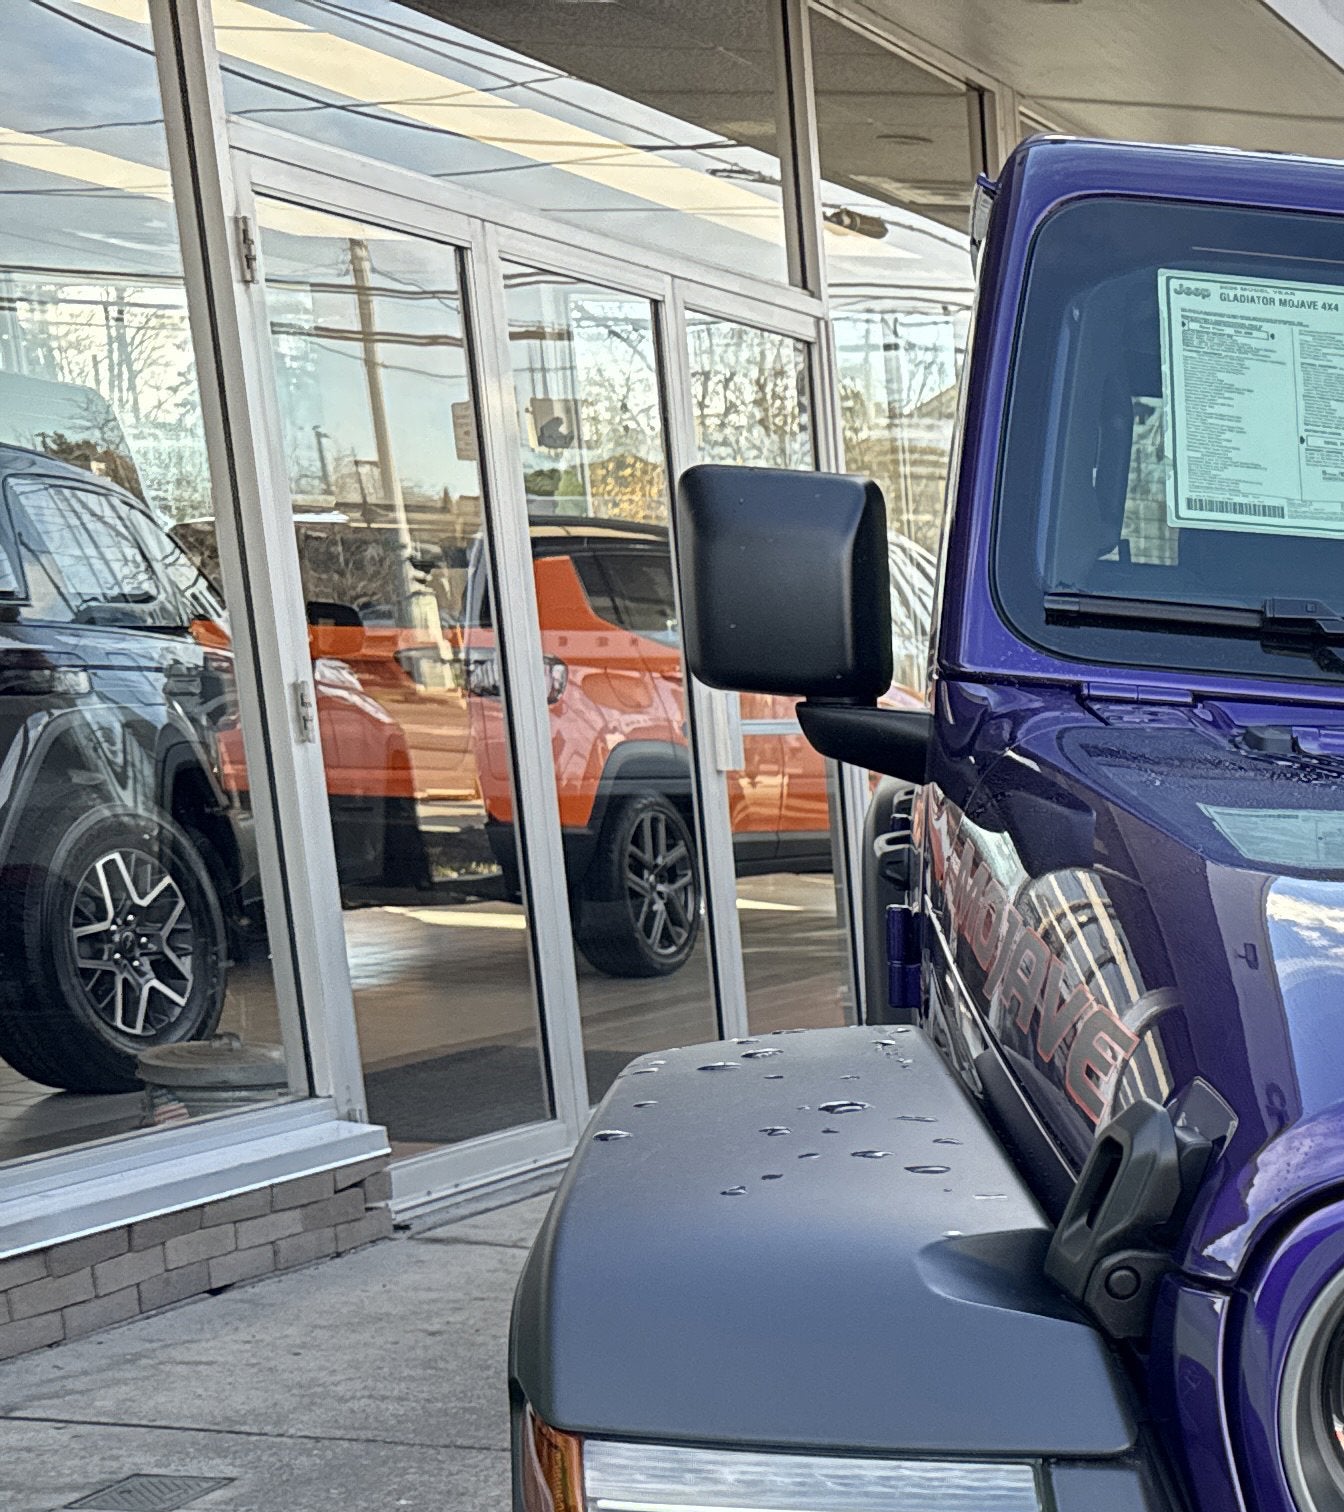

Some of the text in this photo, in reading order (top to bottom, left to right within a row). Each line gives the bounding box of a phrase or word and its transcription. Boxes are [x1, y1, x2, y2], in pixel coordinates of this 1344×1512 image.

[1174, 283, 1211, 299] Jeep
[1219, 292, 1276, 307] GLADIATOR
[1279, 298, 1319, 311] MOJAVE
[1321, 302, 1339, 312] 4X4
